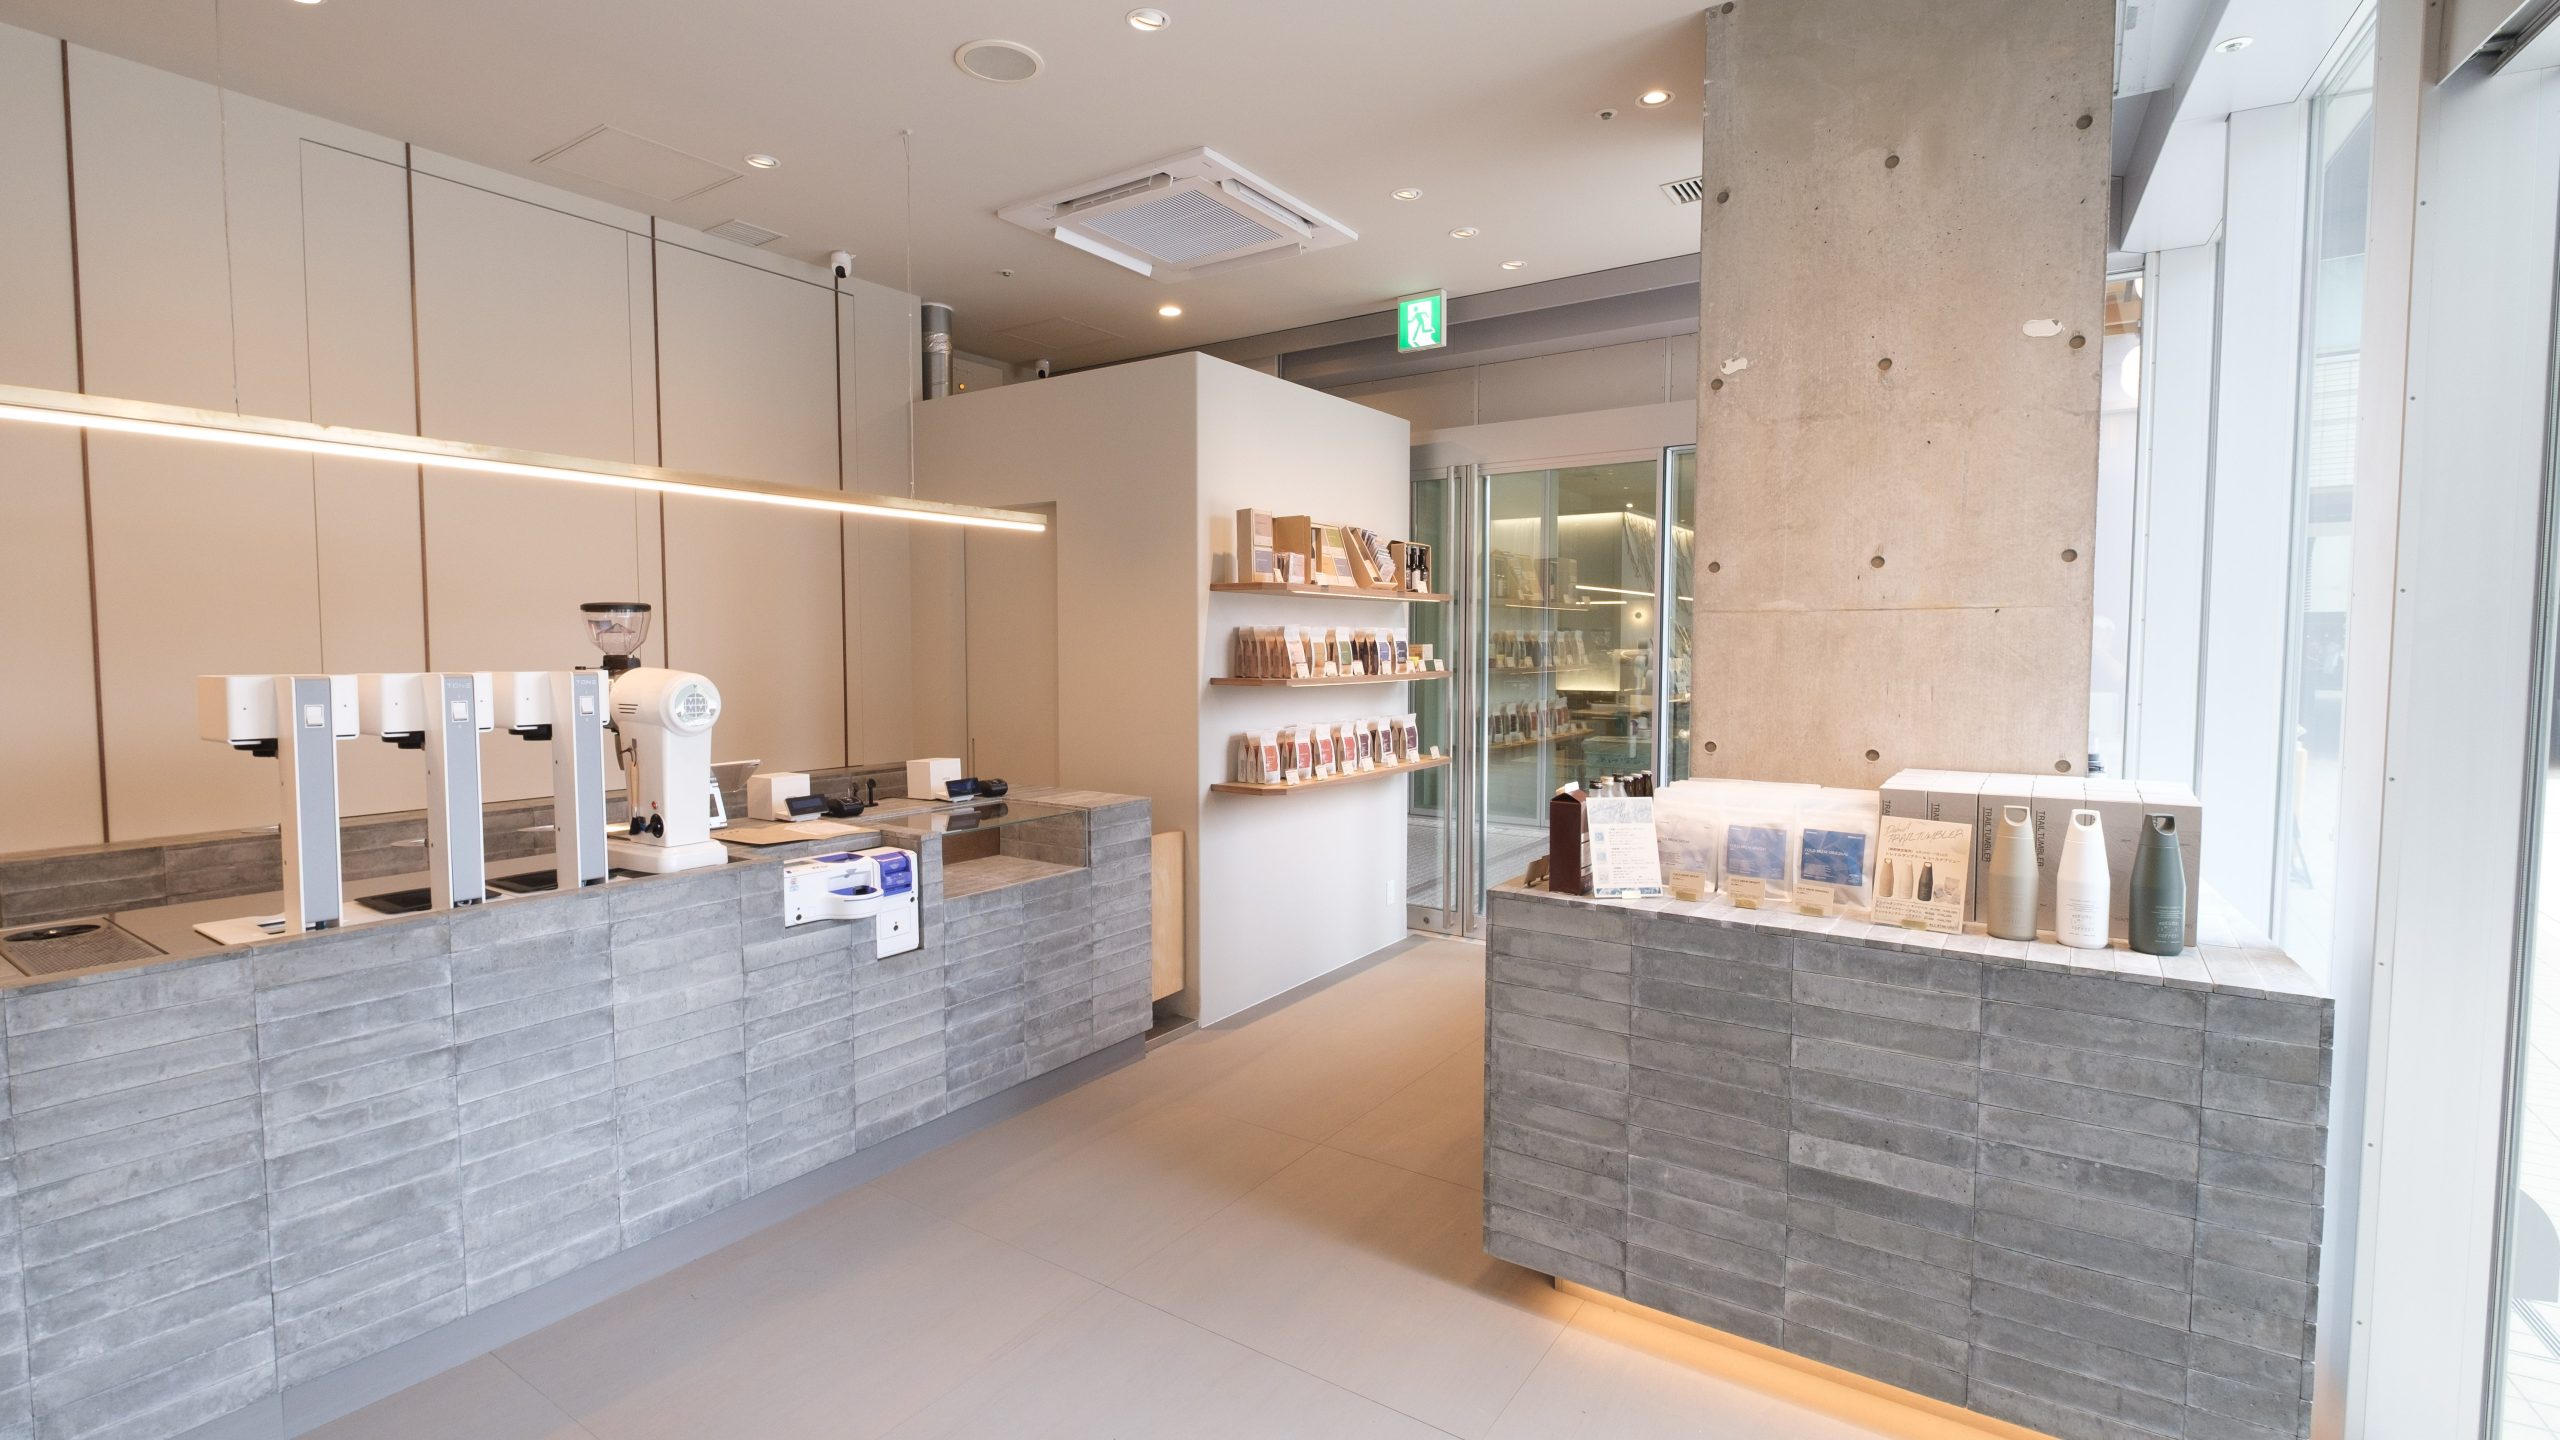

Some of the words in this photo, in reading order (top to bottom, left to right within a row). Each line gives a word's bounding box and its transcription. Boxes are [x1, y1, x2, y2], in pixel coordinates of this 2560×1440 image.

[1984, 807, 1993, 829] TRAIL
[2037, 810, 2046, 832] TRAIL
[1982, 829, 1993, 863] TUMBLER
[2036, 833, 2046, 867] TUMBLER
